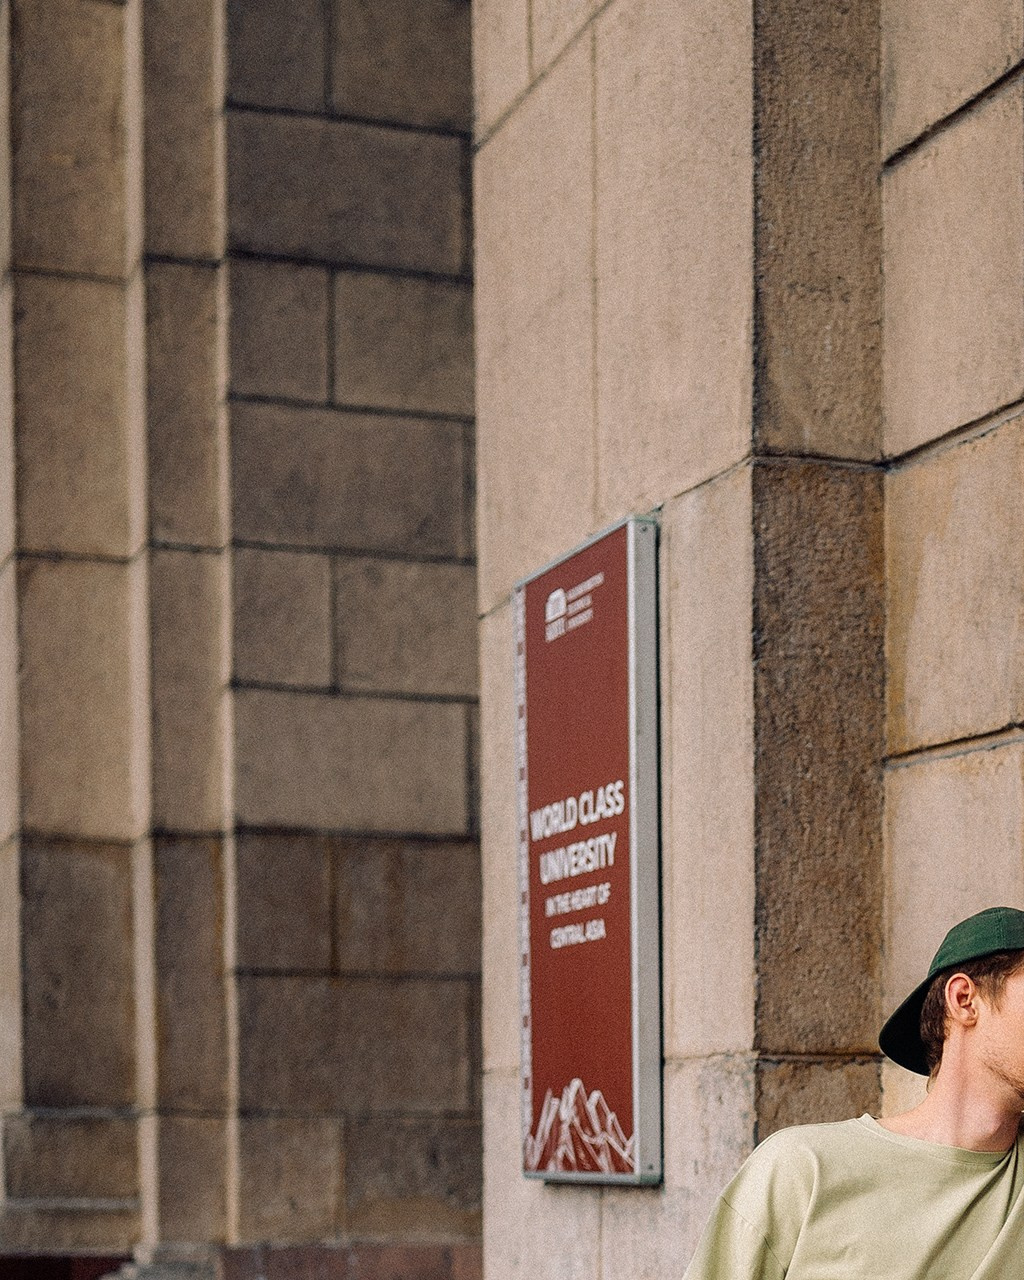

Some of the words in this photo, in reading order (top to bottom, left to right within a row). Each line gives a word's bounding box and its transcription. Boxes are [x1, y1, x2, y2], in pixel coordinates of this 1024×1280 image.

[530, 796, 577, 842] WORLD
[578, 780, 624, 825] CLASS
[539, 832, 617, 885] UNIVERSITY
[597, 882, 611, 905] OF
